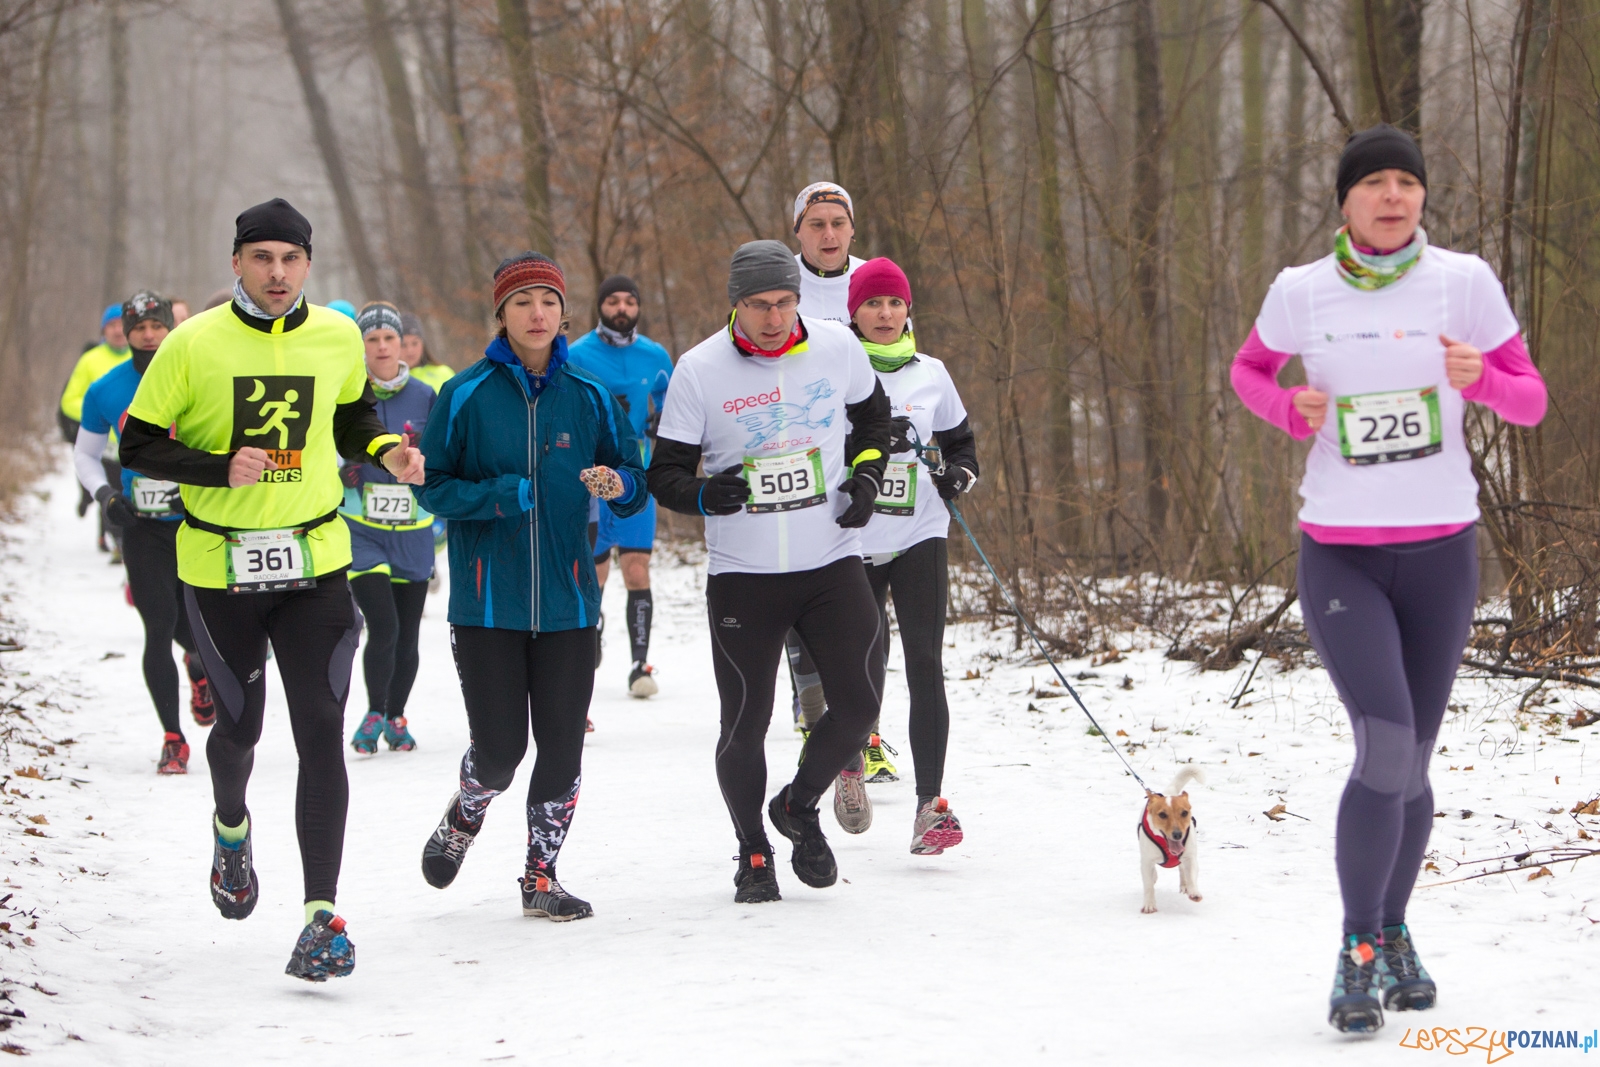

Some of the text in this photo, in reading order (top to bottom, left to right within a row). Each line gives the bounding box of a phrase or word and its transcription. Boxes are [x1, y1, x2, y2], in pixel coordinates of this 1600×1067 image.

[723, 387, 782, 415] speed
[1359, 411, 1422, 442] 226
[762, 436, 813, 451] szuracz
[260, 468, 302, 483] ners
[760, 468, 809, 495] 503
[140, 490, 171, 505] 172
[879, 478, 906, 498] 03
[371, 497, 410, 513] 1273
[246, 546, 293, 572] 361
